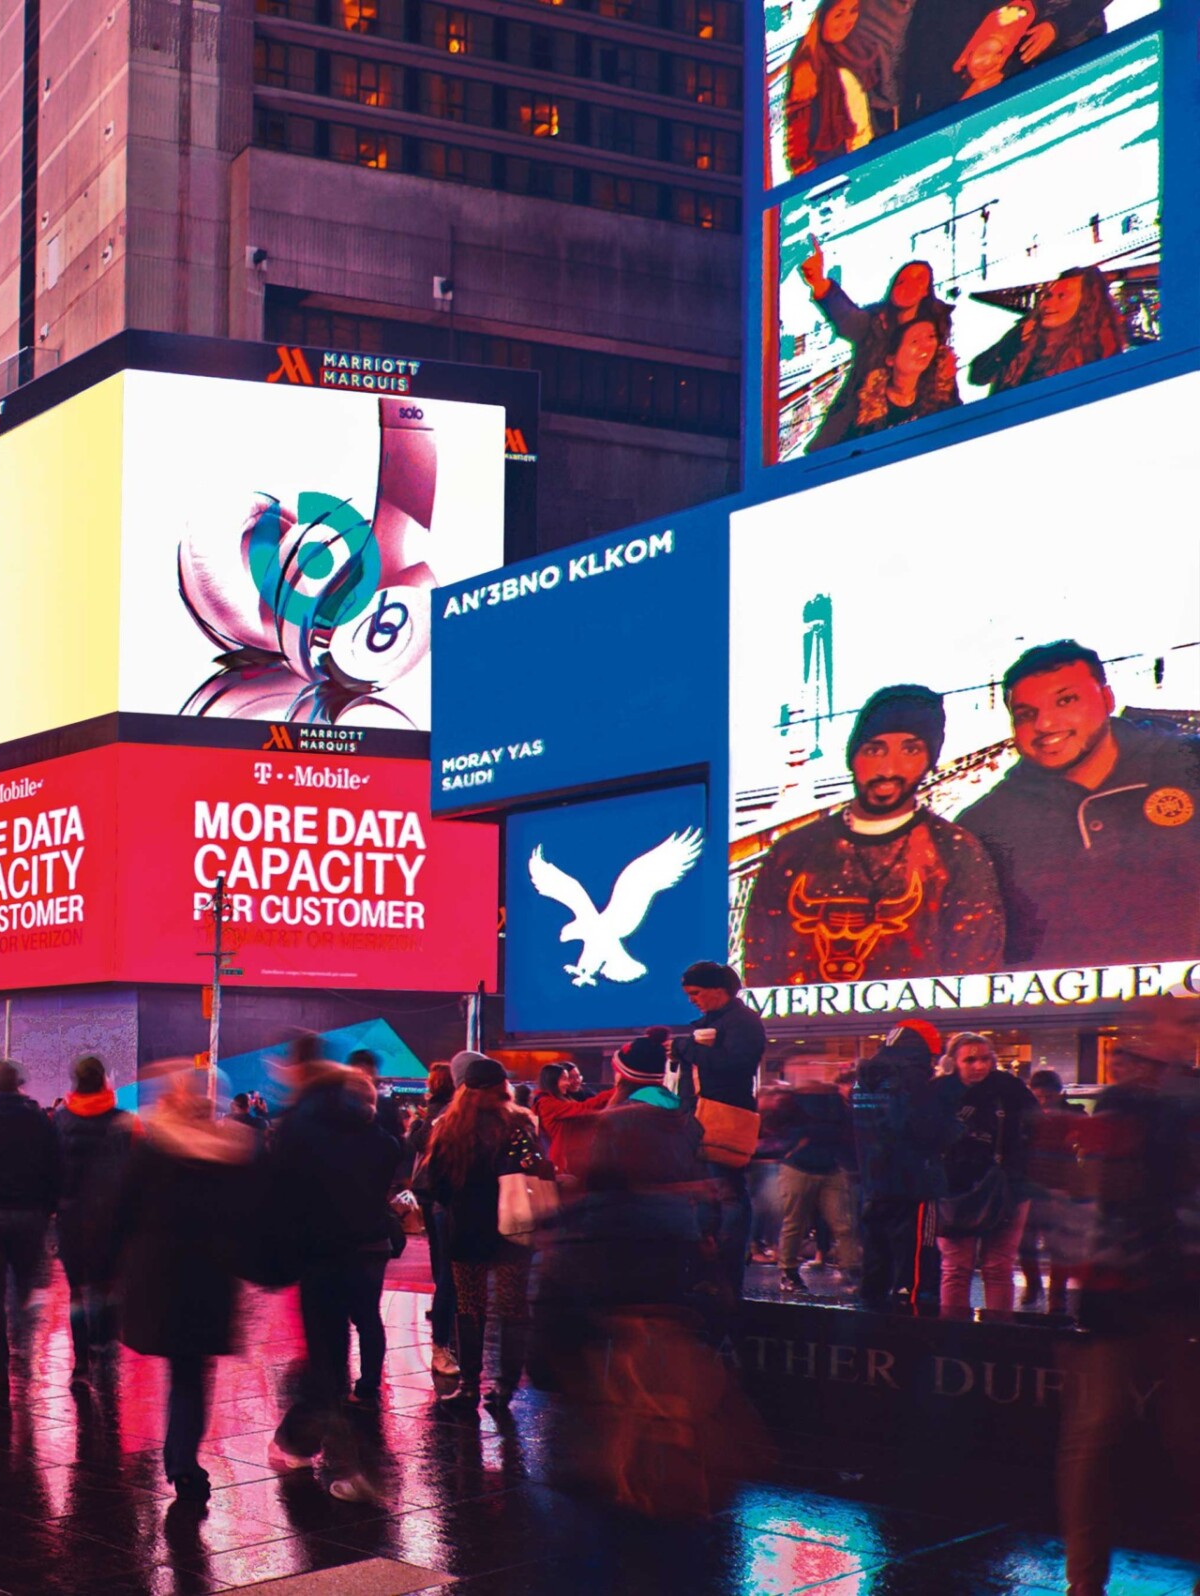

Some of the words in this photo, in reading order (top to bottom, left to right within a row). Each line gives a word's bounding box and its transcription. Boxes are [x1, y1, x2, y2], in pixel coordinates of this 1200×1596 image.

[322, 352, 421, 375] MARRIOTT
[322, 372, 409, 392] MARQUIS
[398, 404, 424, 421] solo
[443, 565, 563, 619] AN'3BNO
[568, 529, 675, 582] KLKOM
[299, 728, 364, 741] MARRIOTT
[299, 740, 356, 753] MARQUIS
[441, 747, 503, 774] MORAY
[507, 739, 545, 761] YAS
[441, 768, 494, 792] SAUDI
[13, 805, 85, 853] DATA
[194, 800, 318, 844] MORE
[327, 807, 426, 849] DATA
[193, 843, 426, 897] CAPACITY
[260, 895, 425, 930] CUSTOMER
[0, 935, 19, 953] OR
[21, 928, 84, 951] VERIZON
[742, 977, 963, 1017] MERICAN
[989, 964, 1163, 1004] EAGLE
